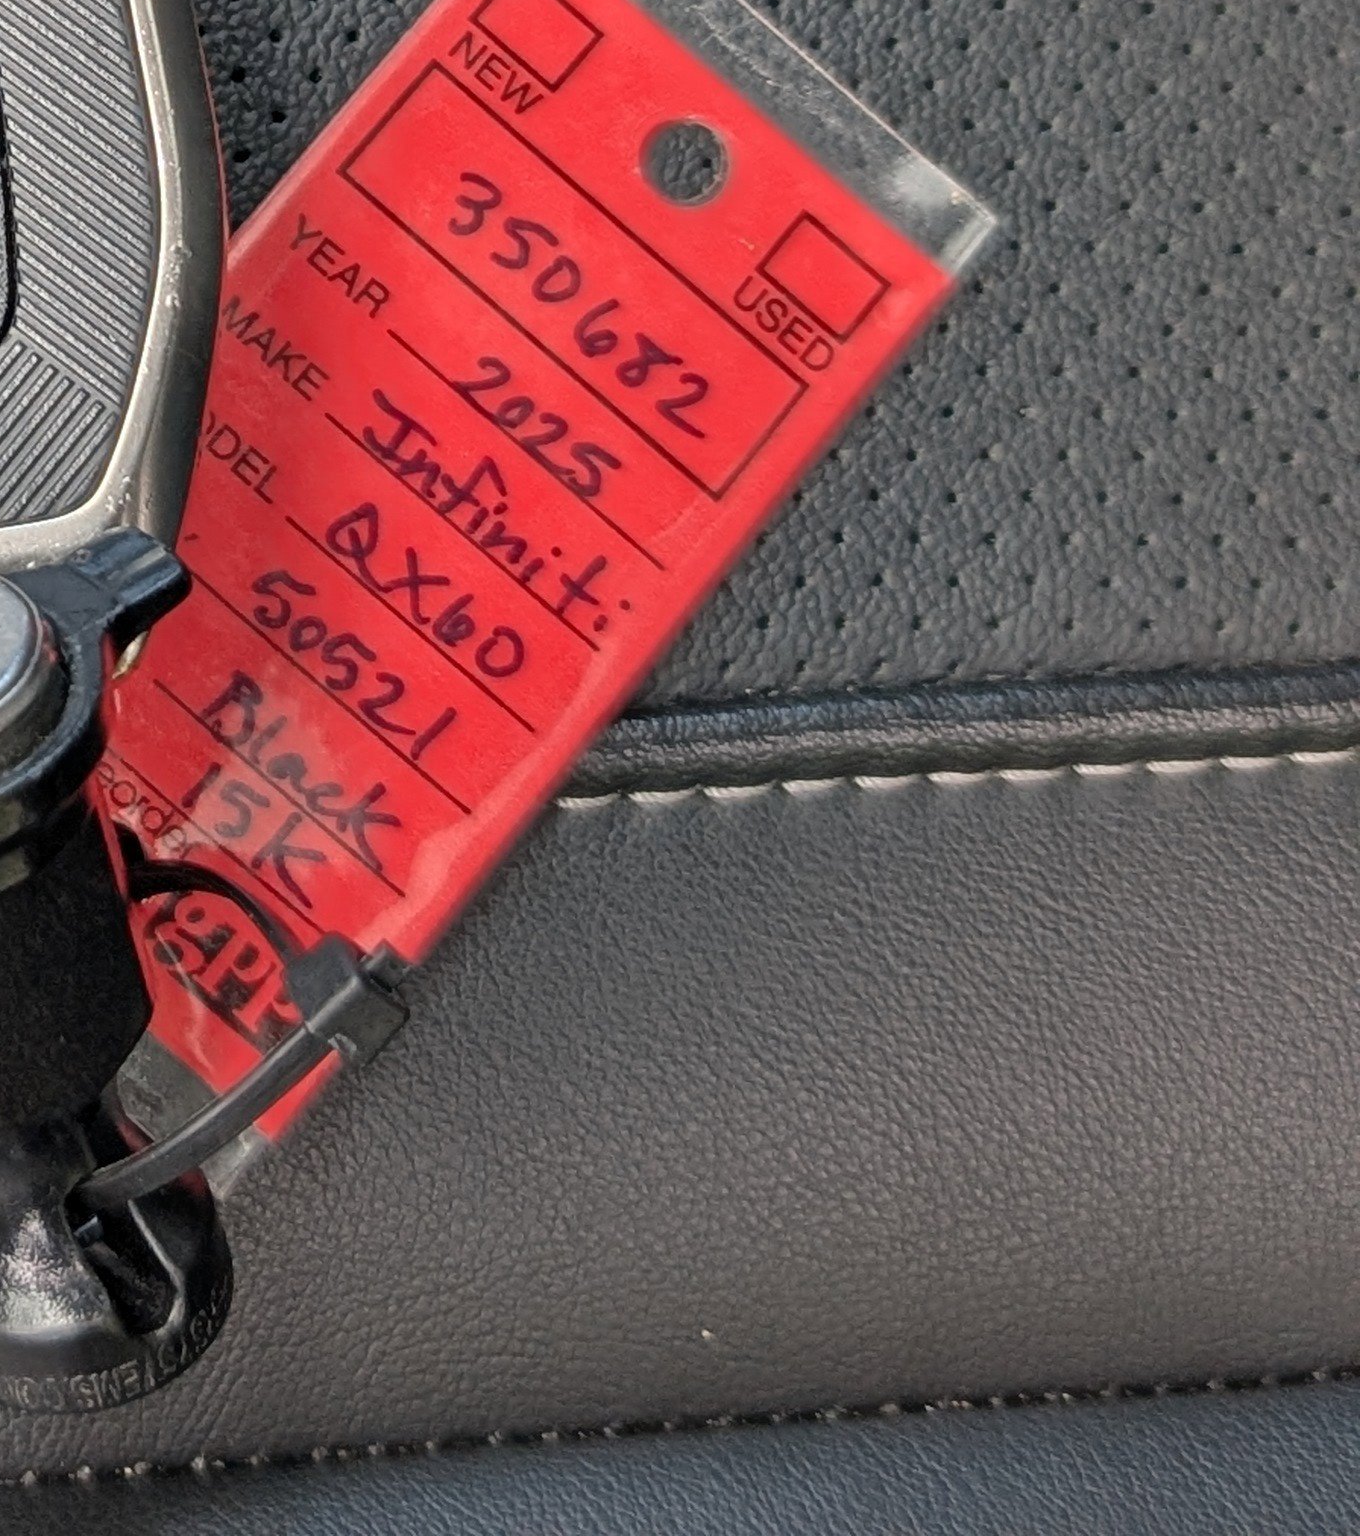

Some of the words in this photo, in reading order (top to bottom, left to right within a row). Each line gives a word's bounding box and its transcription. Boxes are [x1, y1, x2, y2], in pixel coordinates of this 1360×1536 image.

[447, 30, 544, 116] NEW
[289, 213, 391, 319] YEAR
[447, 172, 709, 438] 350682
[732, 276, 835, 372] USED
[221, 294, 329, 402] MAKE
[206, 409, 277, 505] DEL
[452, 355, 621, 499] 2025
[325, 501, 526, 678] QX60
[252, 570, 457, 763] 50521
[182, 762, 329, 910] 15K
[201, 669, 402, 872] Black
